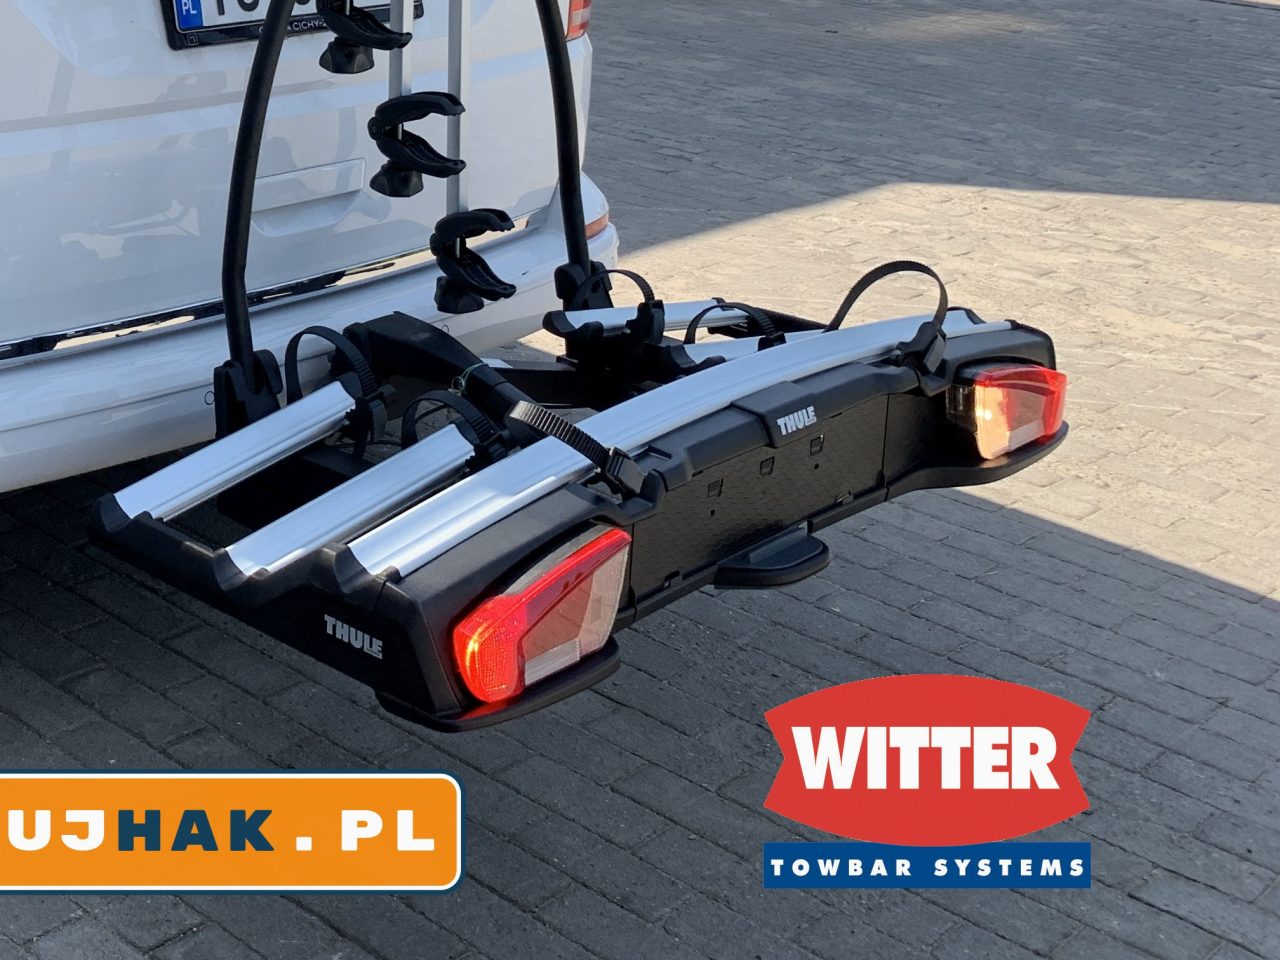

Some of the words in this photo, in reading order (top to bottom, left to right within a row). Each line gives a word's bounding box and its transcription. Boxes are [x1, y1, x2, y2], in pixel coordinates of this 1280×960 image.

[181, 0, 197, 15] PL
[776, 405, 817, 436] THULE
[324, 613, 383, 660] THULE
